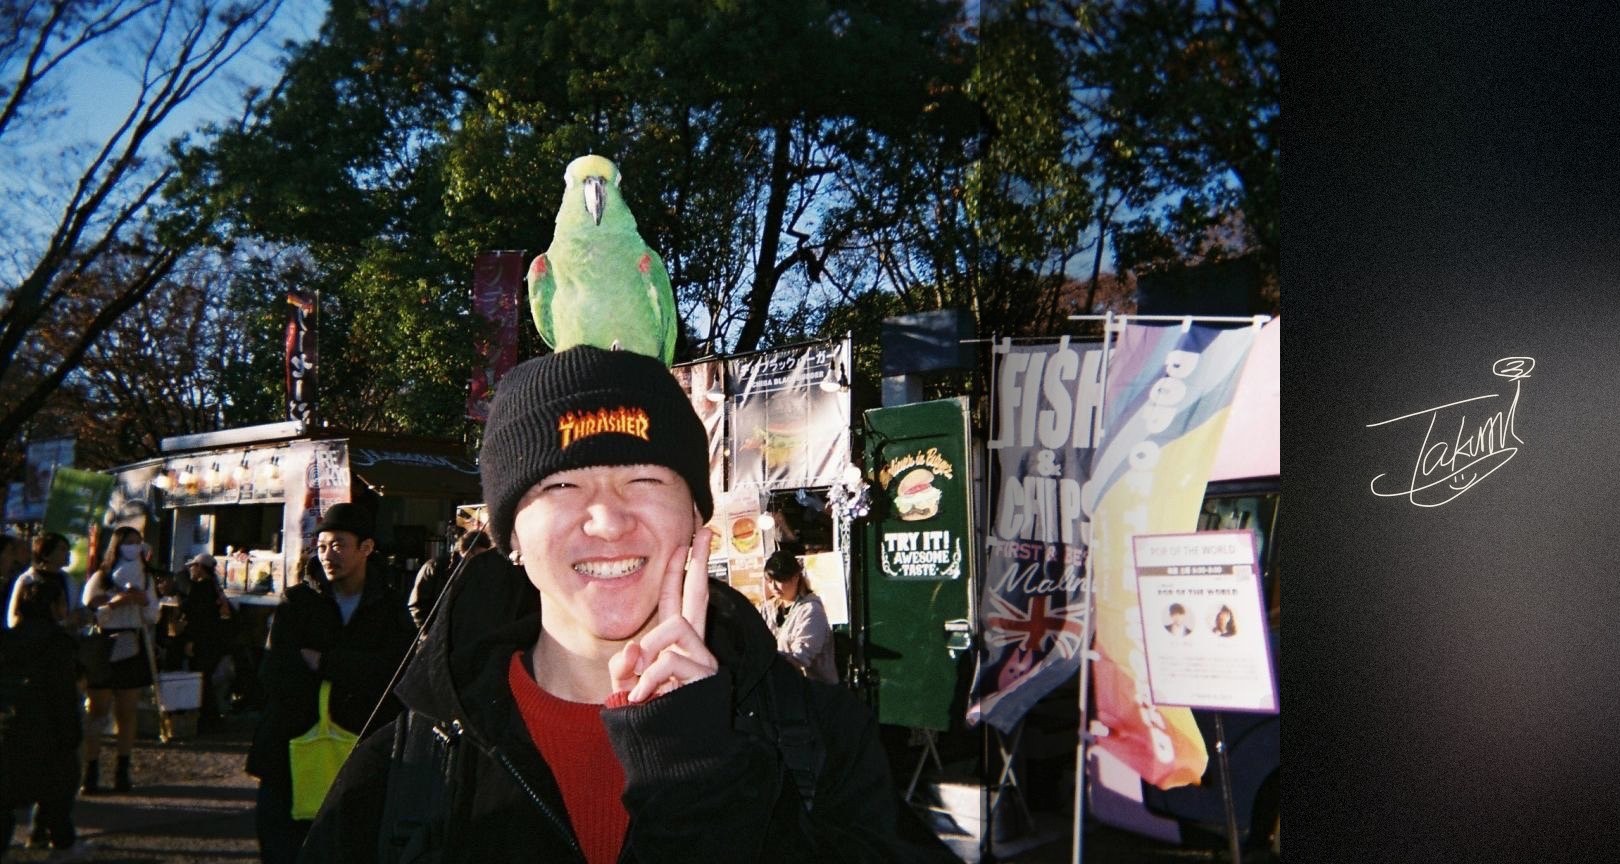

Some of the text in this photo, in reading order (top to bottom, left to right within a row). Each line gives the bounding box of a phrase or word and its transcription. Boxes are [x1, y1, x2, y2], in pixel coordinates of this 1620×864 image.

[998, 347, 1109, 450] FISH
[559, 406, 650, 450] THRASHER
[1037, 450, 1062, 476] &
[999, 475, 1096, 546] CHIPS
[884, 531, 949, 551] TRY IT!
[996, 541, 1042, 560] FIRST
[1184, 545, 1200, 556] THE
[1201, 544, 1236, 555] WORLD
[894, 550, 949, 565] AWESOME
[902, 565, 936, 576] TASTE
